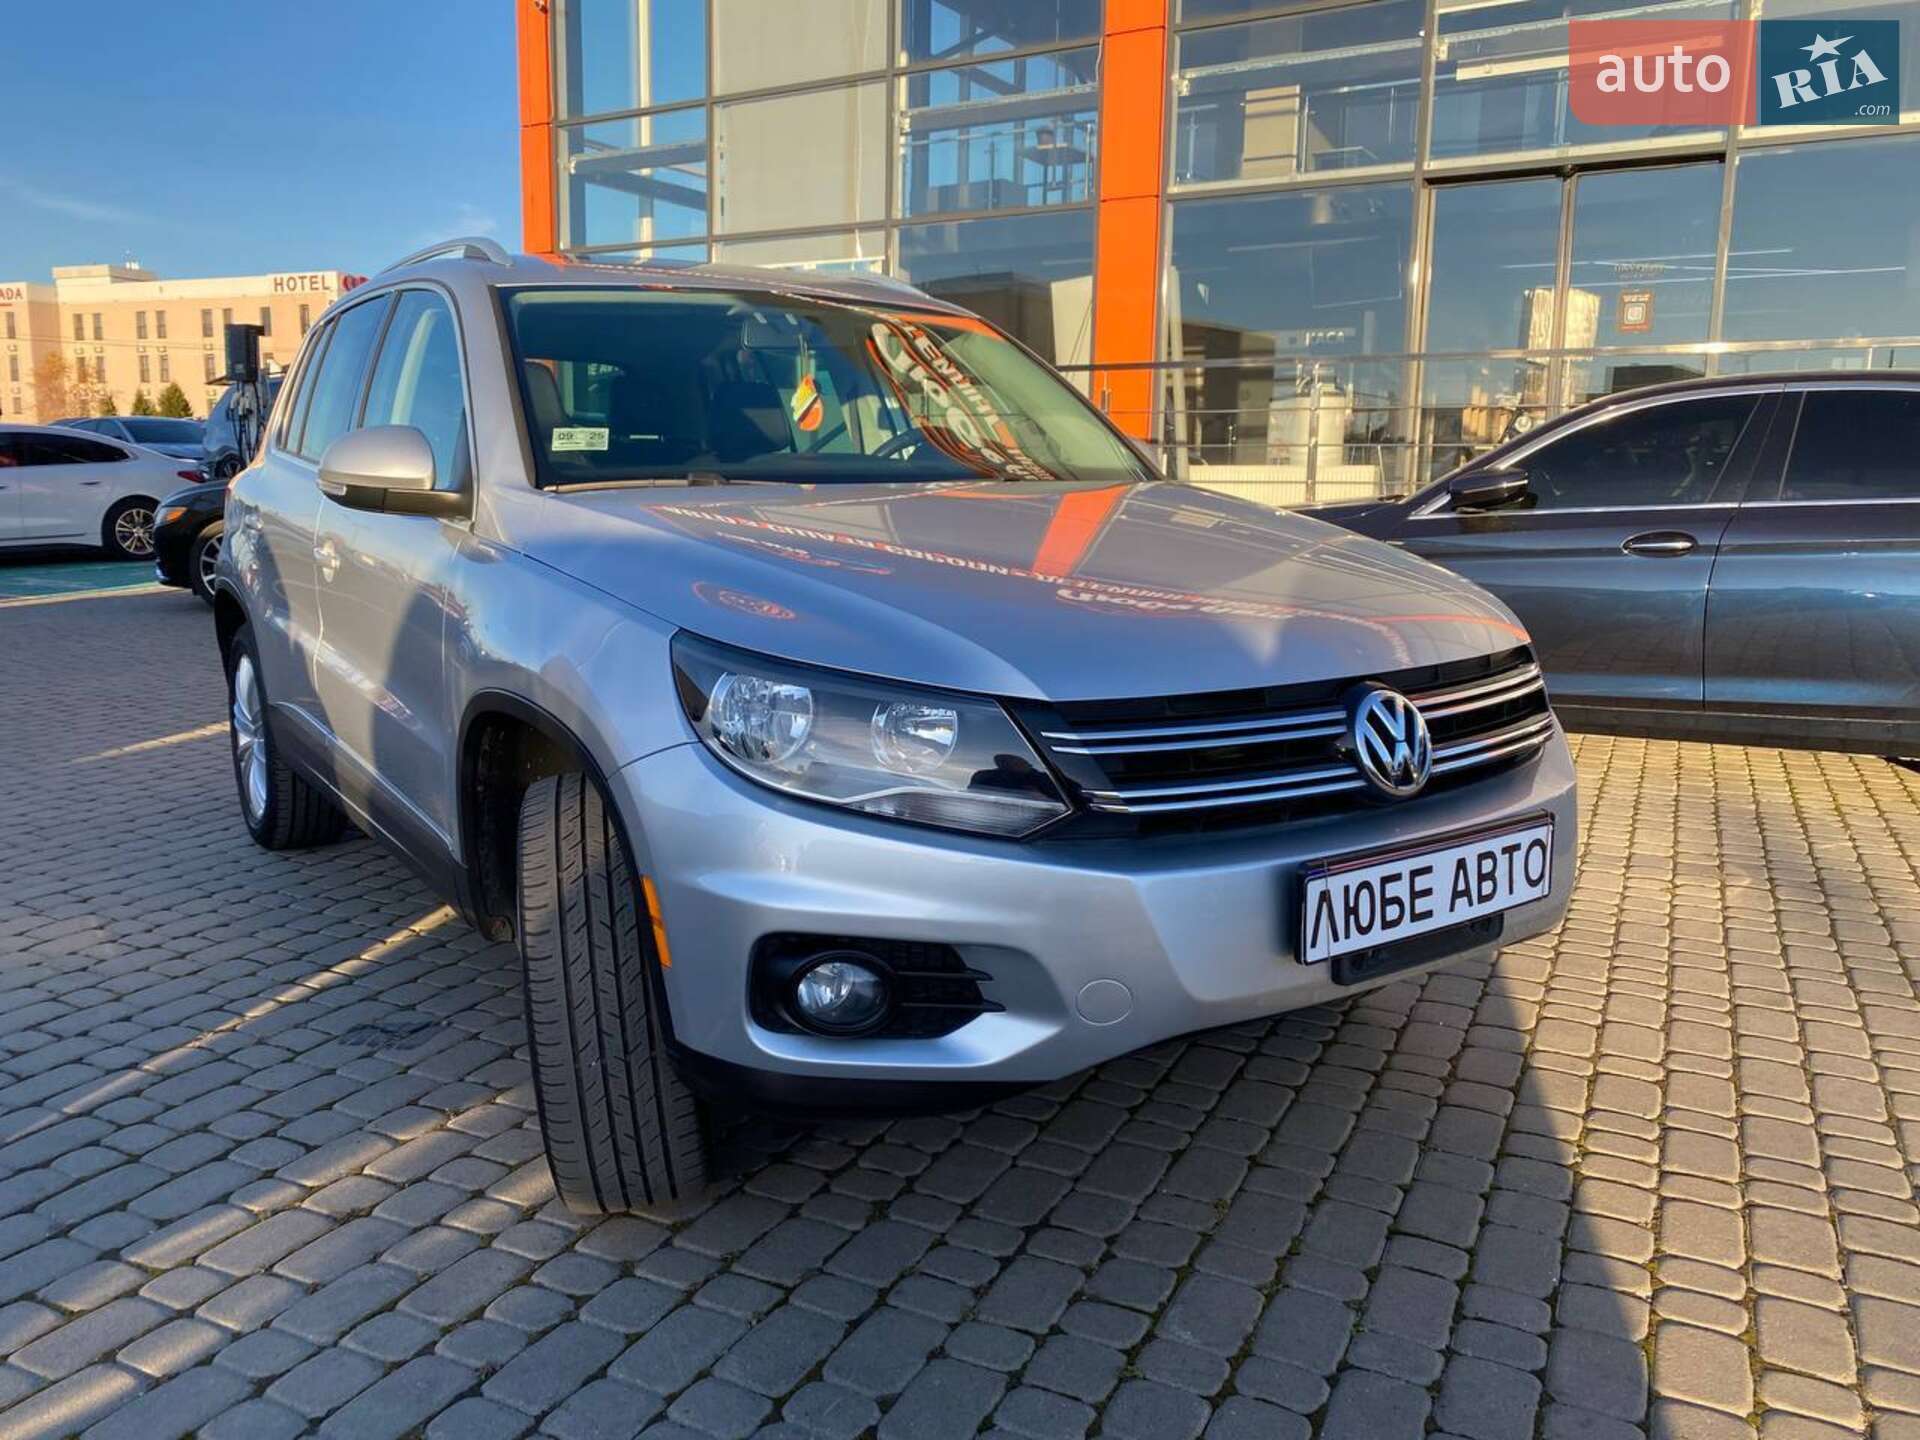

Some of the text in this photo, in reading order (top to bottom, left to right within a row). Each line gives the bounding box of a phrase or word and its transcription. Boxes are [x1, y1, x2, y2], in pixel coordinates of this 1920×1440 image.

[273, 274, 331, 293] HOTEL
[1310, 838, 1548, 949] ЛЮБЕ АВТО
